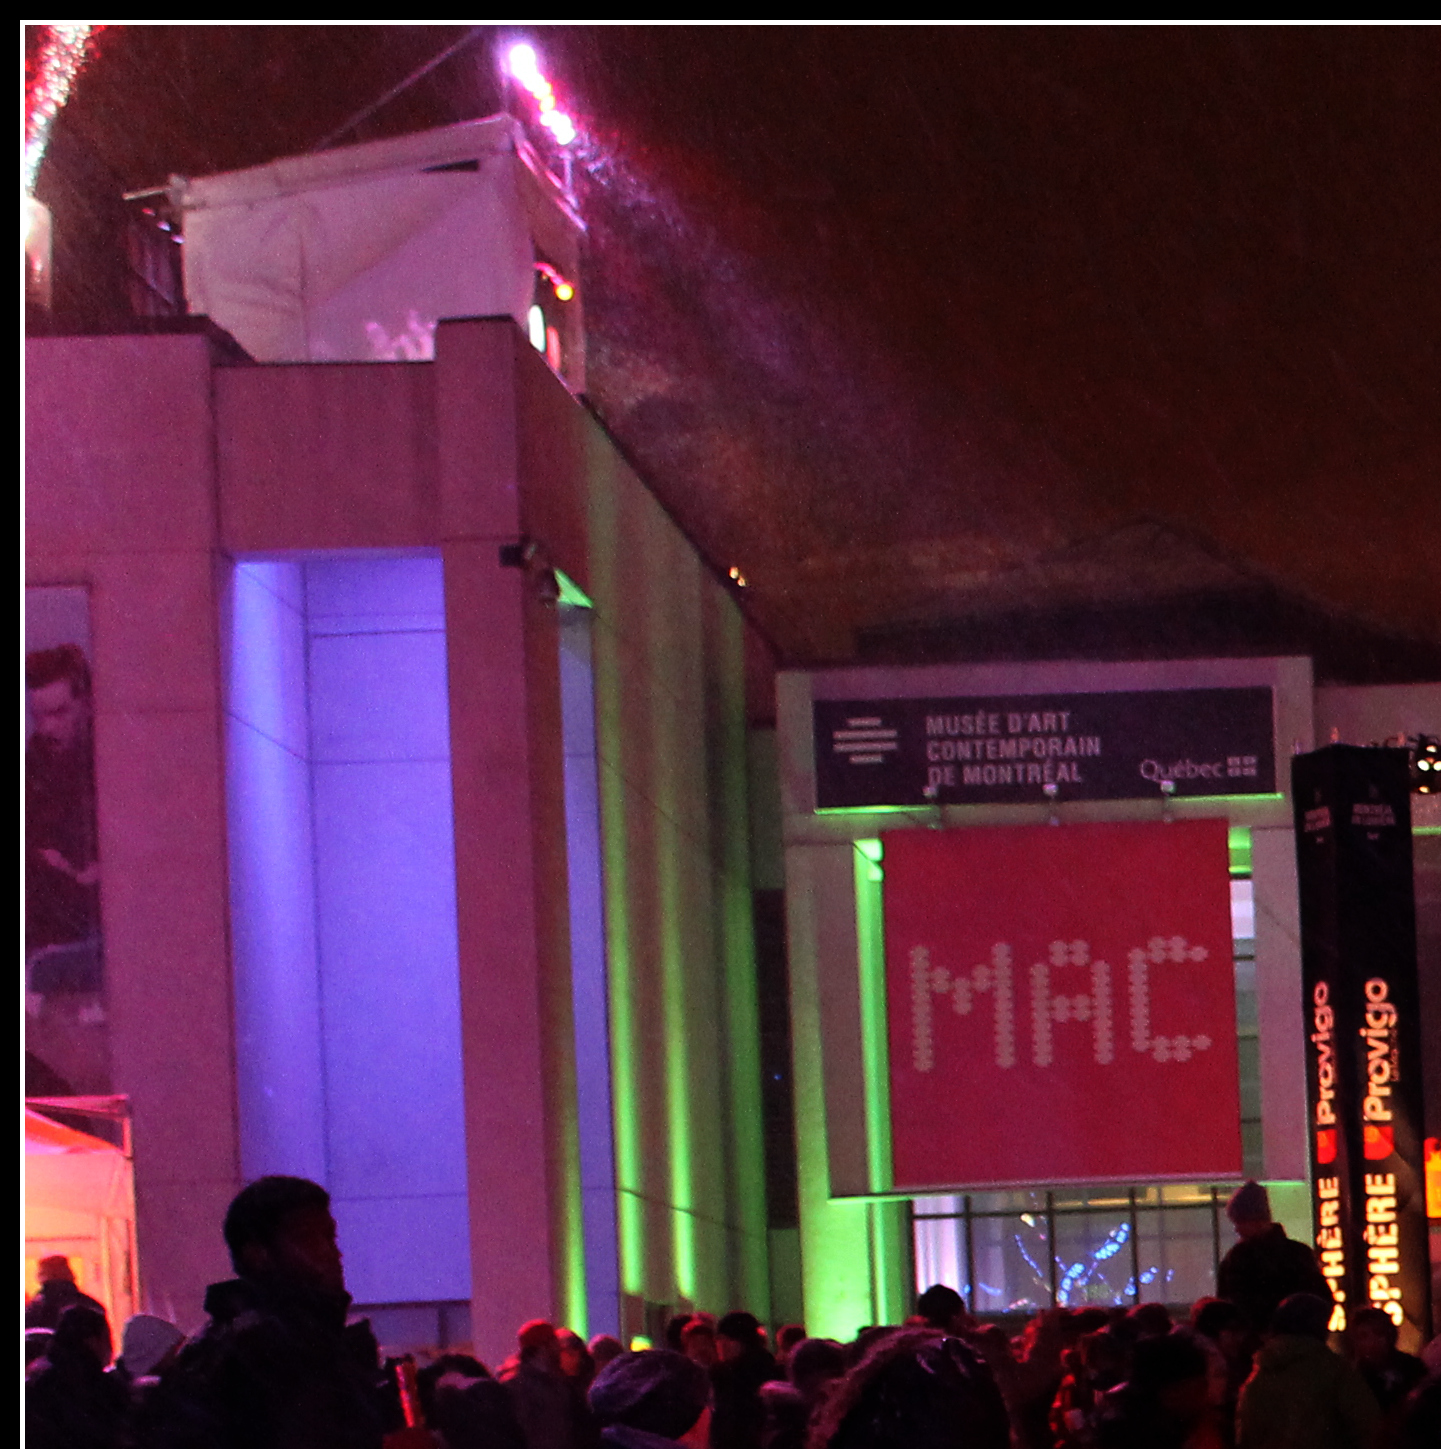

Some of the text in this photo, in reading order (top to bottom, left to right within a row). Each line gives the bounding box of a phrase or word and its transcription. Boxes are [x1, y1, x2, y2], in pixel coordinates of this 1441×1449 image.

[925, 709, 1071, 737] MUSÉE D'ART
[926, 736, 1102, 762] CONTEMPORAIN
[926, 759, 1083, 787] DE MONTRÉAL
[1140, 758, 1224, 784] Québec
[908, 935, 1213, 1074] MAC
[1310, 980, 1337, 1126] Provigo
[1358, 976, 1399, 1122] Provigo
